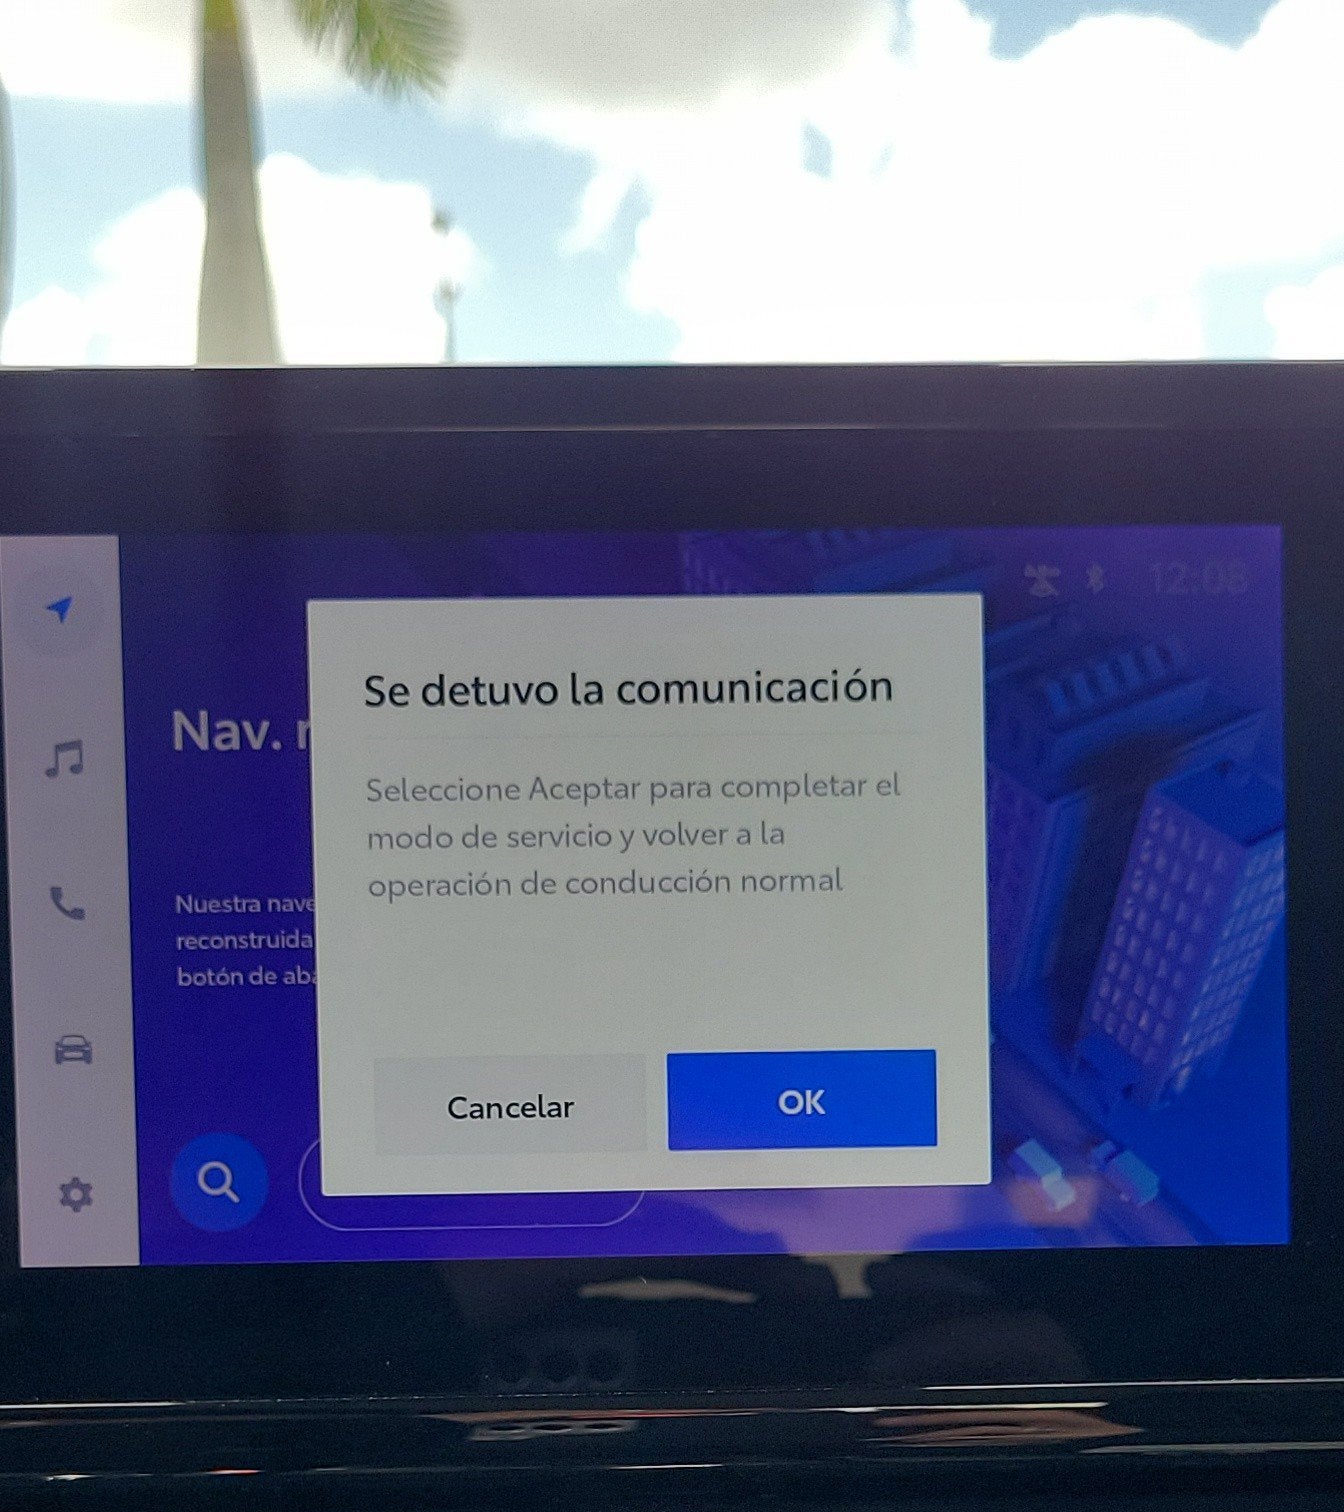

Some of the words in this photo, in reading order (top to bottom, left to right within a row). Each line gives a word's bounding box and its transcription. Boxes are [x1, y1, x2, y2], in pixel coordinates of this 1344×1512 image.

[365, 675, 410, 707] Se
[422, 673, 558, 707] detuvo
[571, 672, 603, 705] la
[617, 668, 892, 705] comunicación
[172, 710, 282, 751] Nav.
[367, 777, 521, 802] Seleccione
[529, 776, 641, 807] Aceptar
[650, 780, 712, 806] para
[721, 773, 868, 804] completar
[876, 771, 902, 797] el
[368, 825, 454, 850] modo
[462, 824, 498, 848] de
[507, 824, 612, 848] servicio
[619, 829, 635, 854] y
[643, 822, 729, 846] volver
[736, 828, 752, 846] a
[761, 820, 785, 846] la
[369, 870, 511, 904] operación
[521, 869, 557, 895] de
[566, 869, 731, 896] conducción
[741, 867, 844, 892] normal
[175, 894, 262, 915] Nuestra
[176, 930, 314, 951] reconstruida
[178, 966, 244, 986] botón
[249, 966, 278, 986] de
[447, 1094, 576, 1121] Cancelar
[778, 1089, 826, 1115] OK
